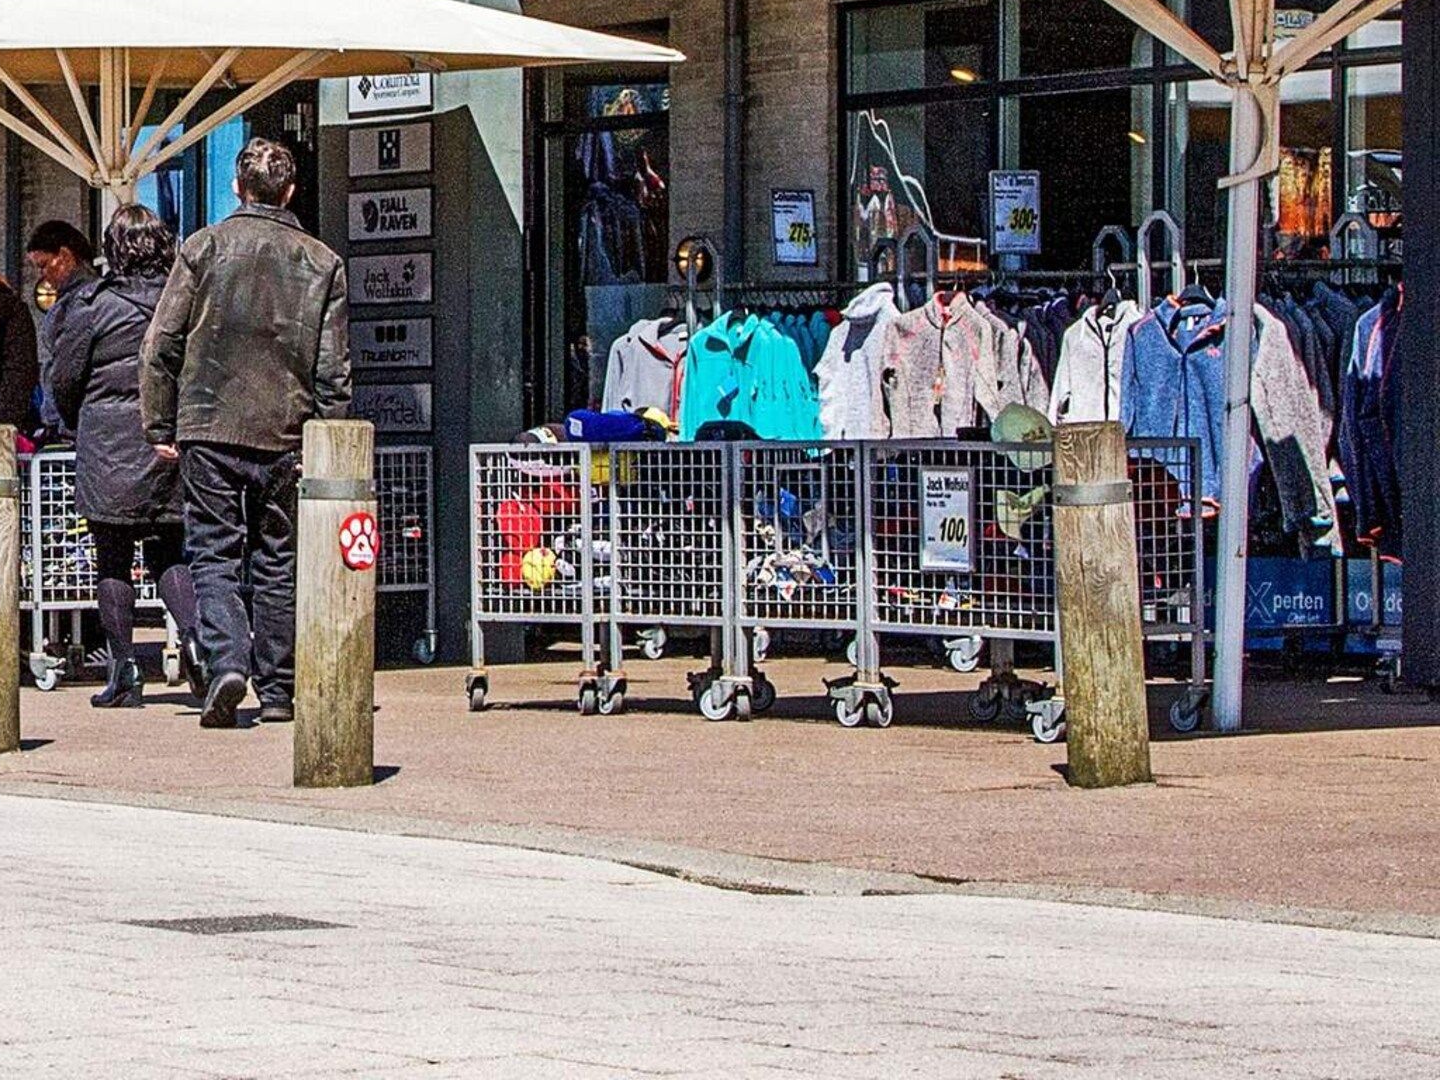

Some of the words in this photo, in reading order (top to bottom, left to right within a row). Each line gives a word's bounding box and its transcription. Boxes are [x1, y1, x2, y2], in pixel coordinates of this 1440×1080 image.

[380, 212, 419, 232] RAVEN
[364, 268, 390, 284] Jack
[926, 476, 943, 491] Jack
